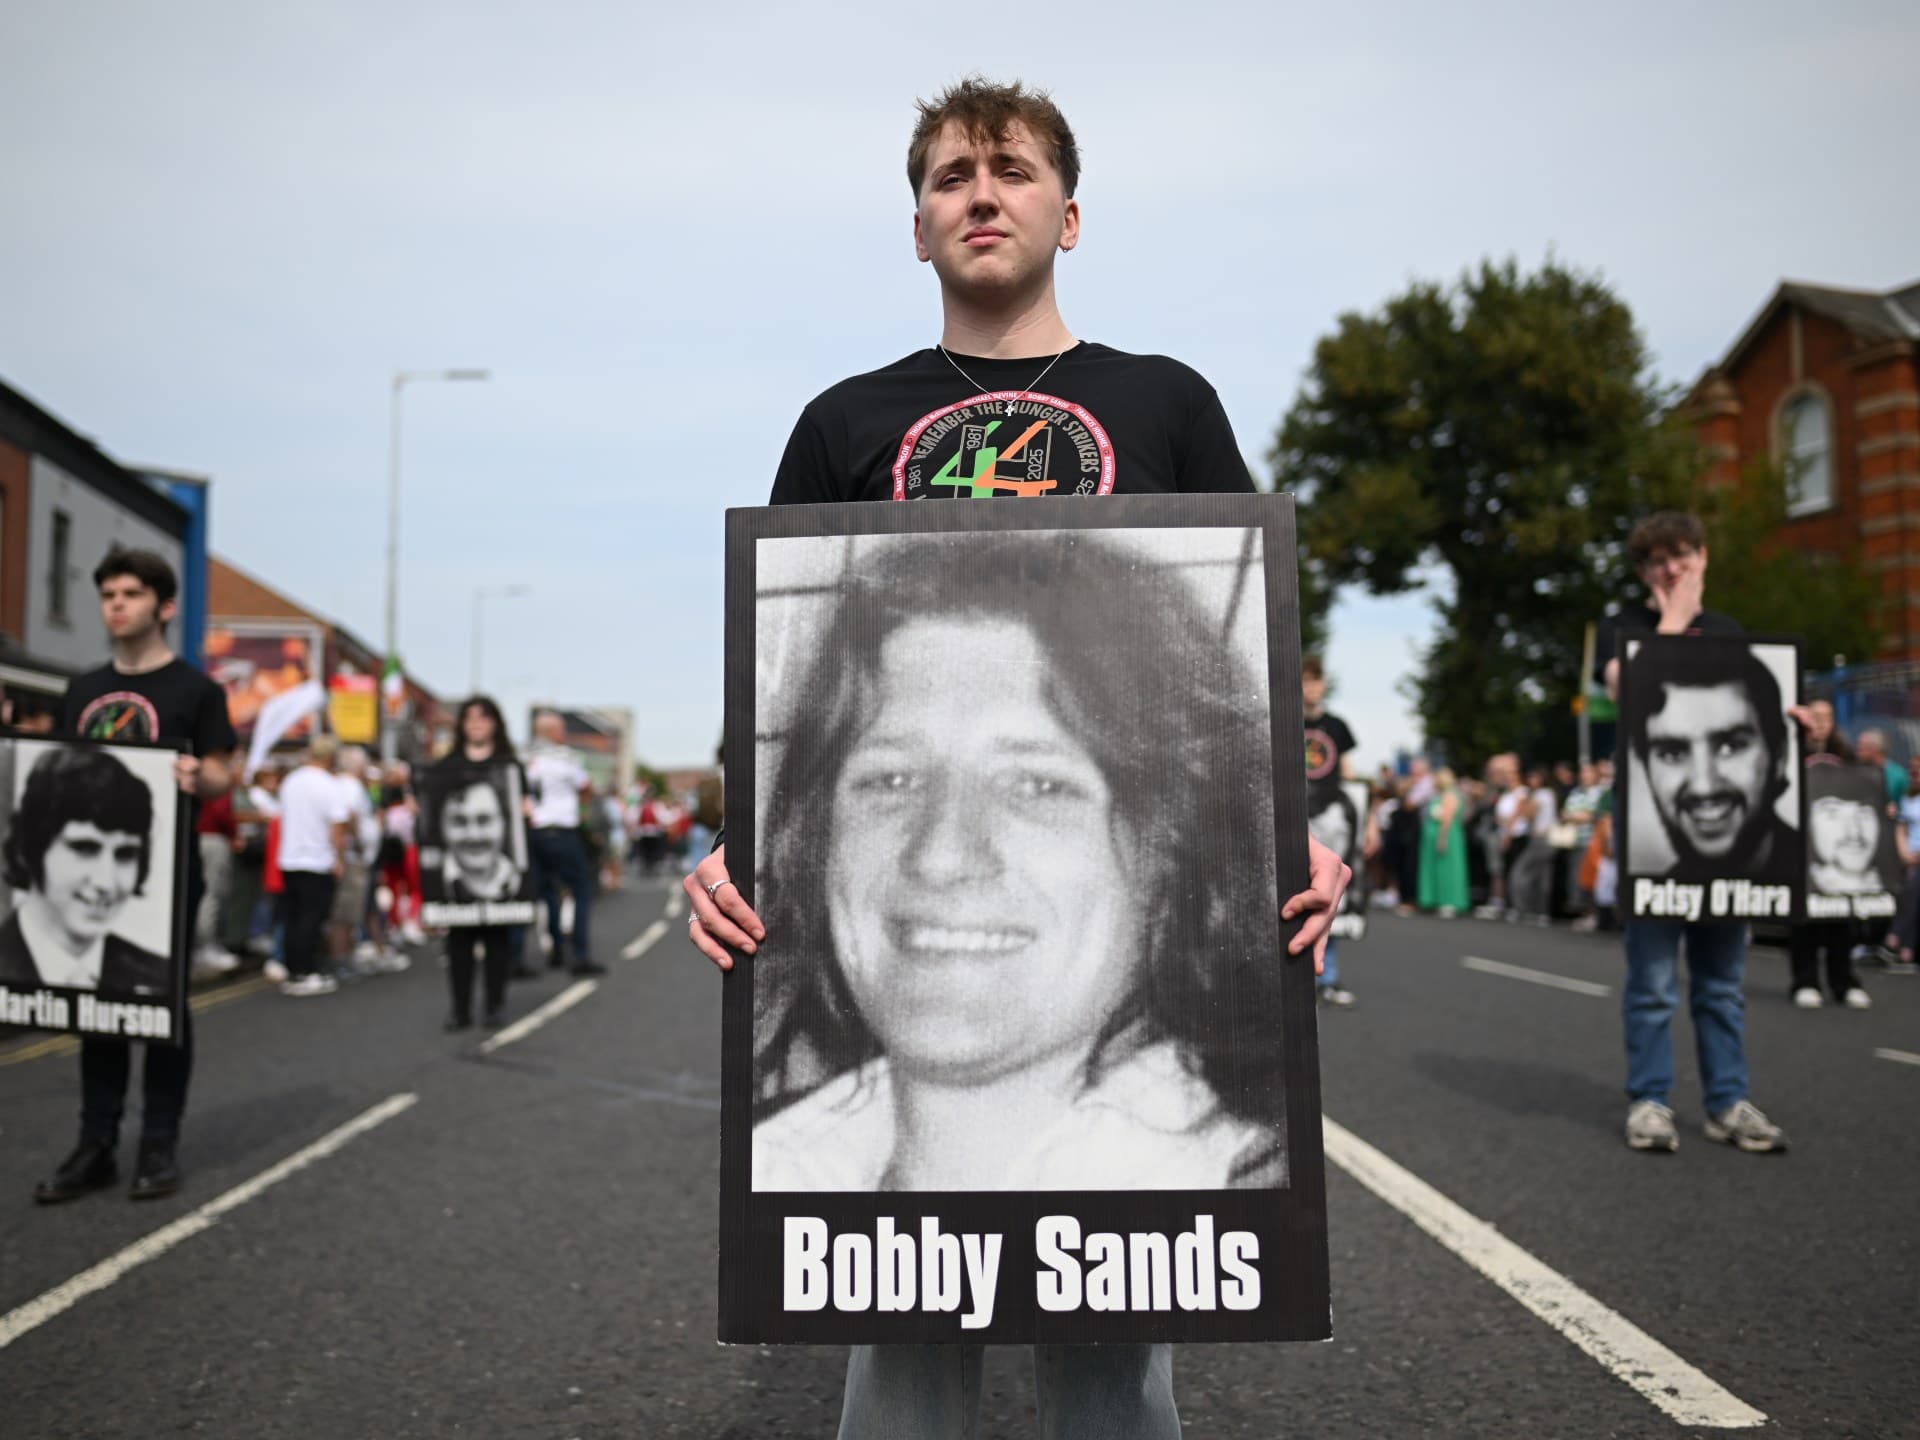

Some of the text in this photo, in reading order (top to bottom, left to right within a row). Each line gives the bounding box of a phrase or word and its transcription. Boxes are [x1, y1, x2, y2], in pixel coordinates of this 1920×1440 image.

[964, 393, 992, 405] MICHAEL
[966, 427, 983, 451] 1981
[974, 401, 1004, 415] THE
[1062, 420, 1100, 473] STRIKERS
[908, 464, 922, 491] 1981
[1026, 448, 1044, 480] 2025
[1072, 477, 1095, 497] 25
[1634, 878, 1704, 922] Patsy
[1710, 878, 1791, 916] O'Hara
[77, 993, 171, 1039] Hurson
[783, 1214, 1261, 1329] Bobby Sands
